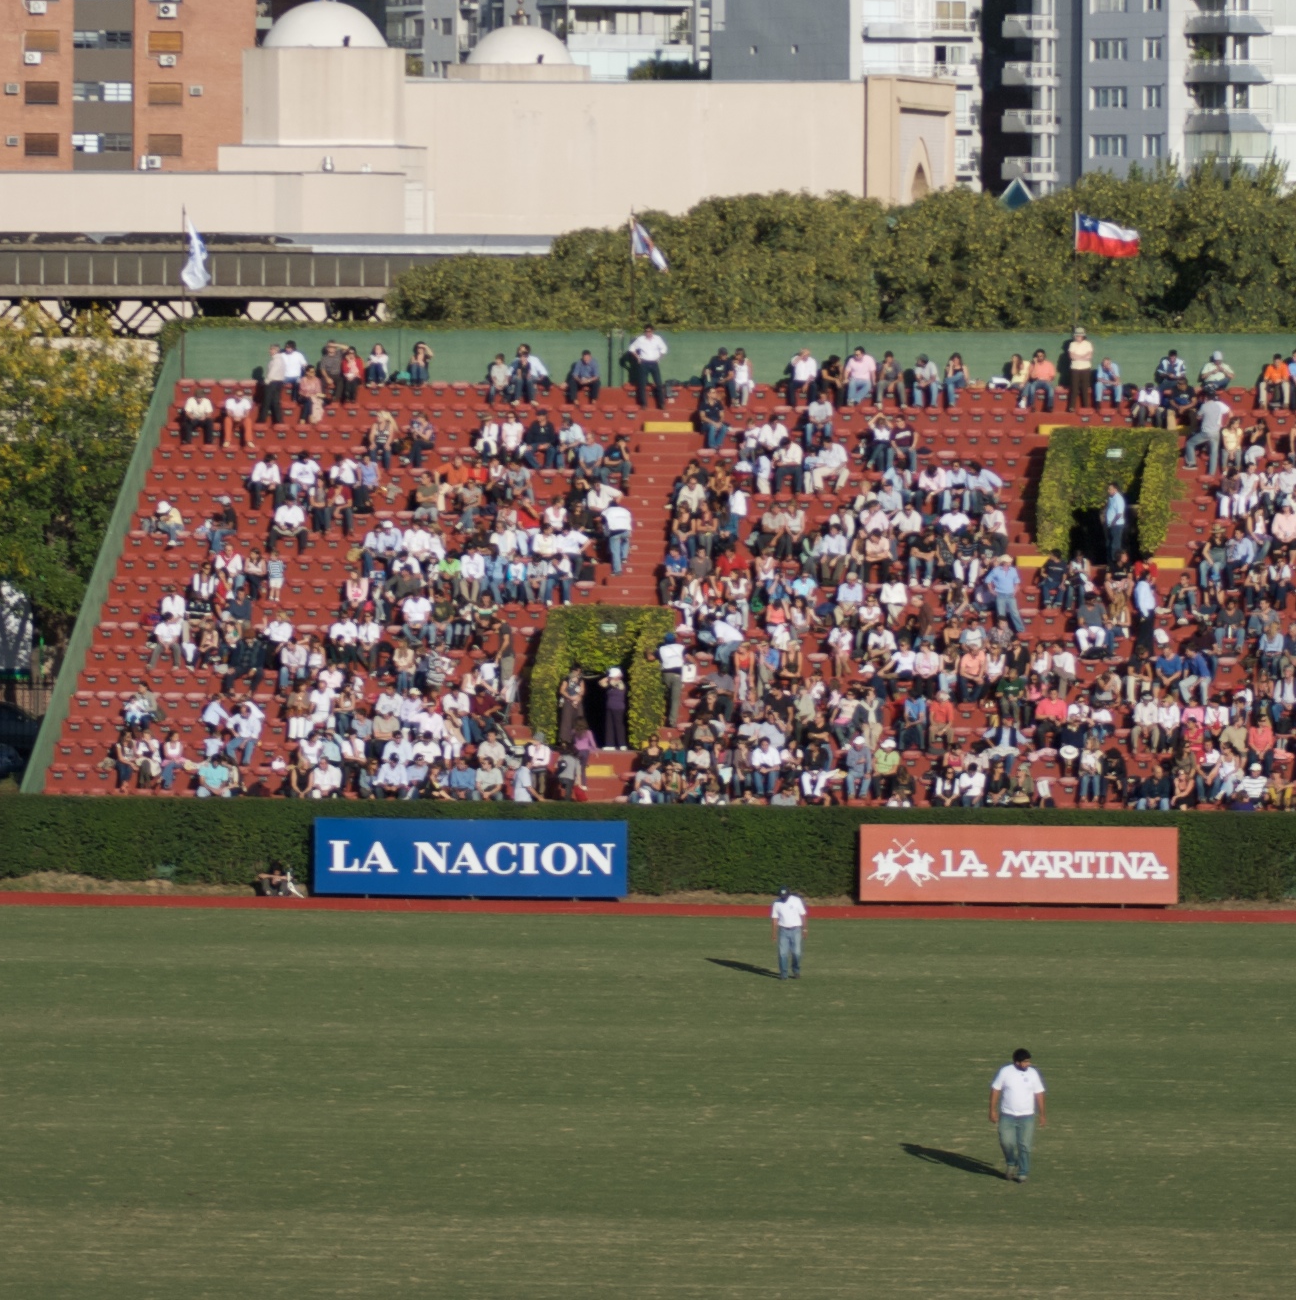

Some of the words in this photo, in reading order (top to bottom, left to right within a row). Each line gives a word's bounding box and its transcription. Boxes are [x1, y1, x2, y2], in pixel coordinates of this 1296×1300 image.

[328, 839, 398, 874] LA
[413, 841, 616, 877] NACION
[939, 849, 990, 879] LA
[995, 850, 1170, 880] MARTINA
